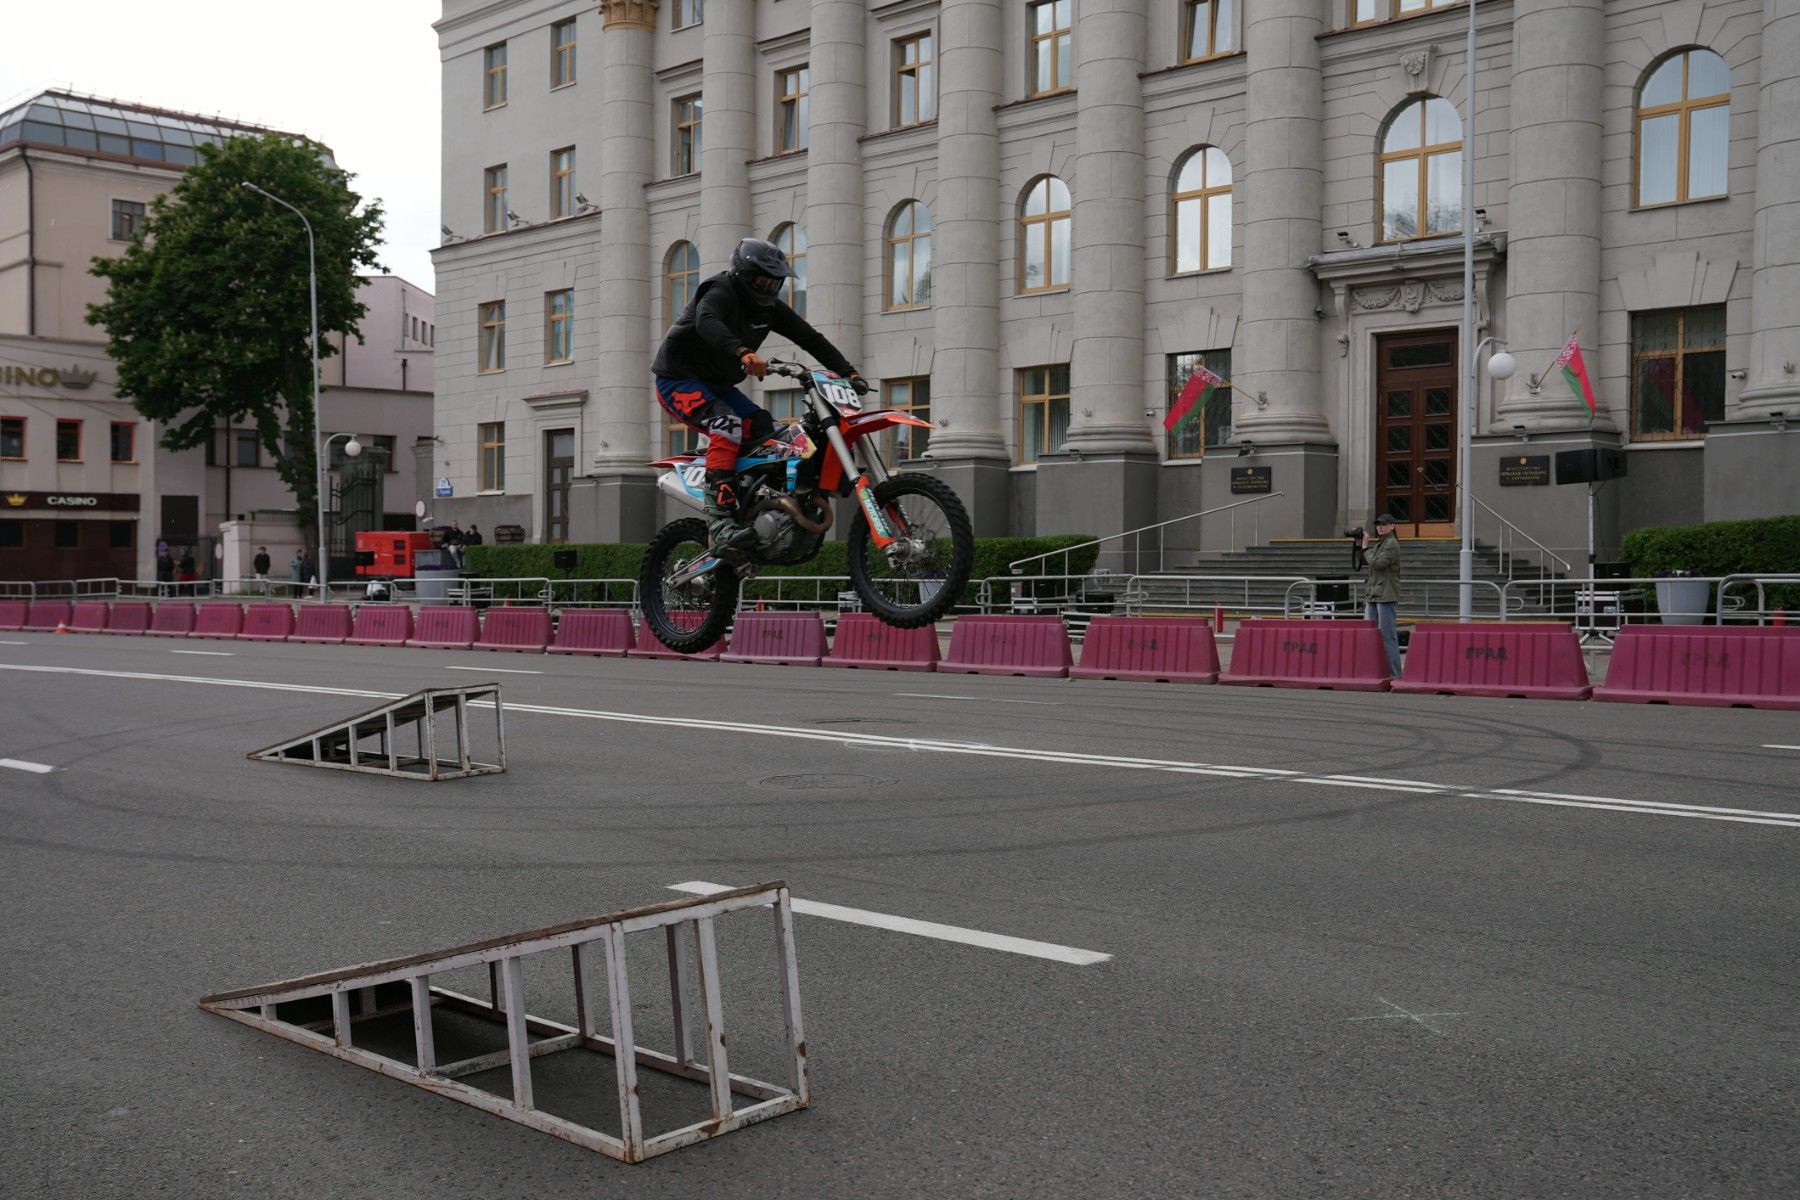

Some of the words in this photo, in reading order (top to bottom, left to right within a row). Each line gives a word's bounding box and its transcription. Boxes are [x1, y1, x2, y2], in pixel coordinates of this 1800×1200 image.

[0, 366, 59, 387] INO
[822, 383, 862, 409] 108
[684, 466, 706, 487] 10
[47, 496, 97, 506] CASINO
